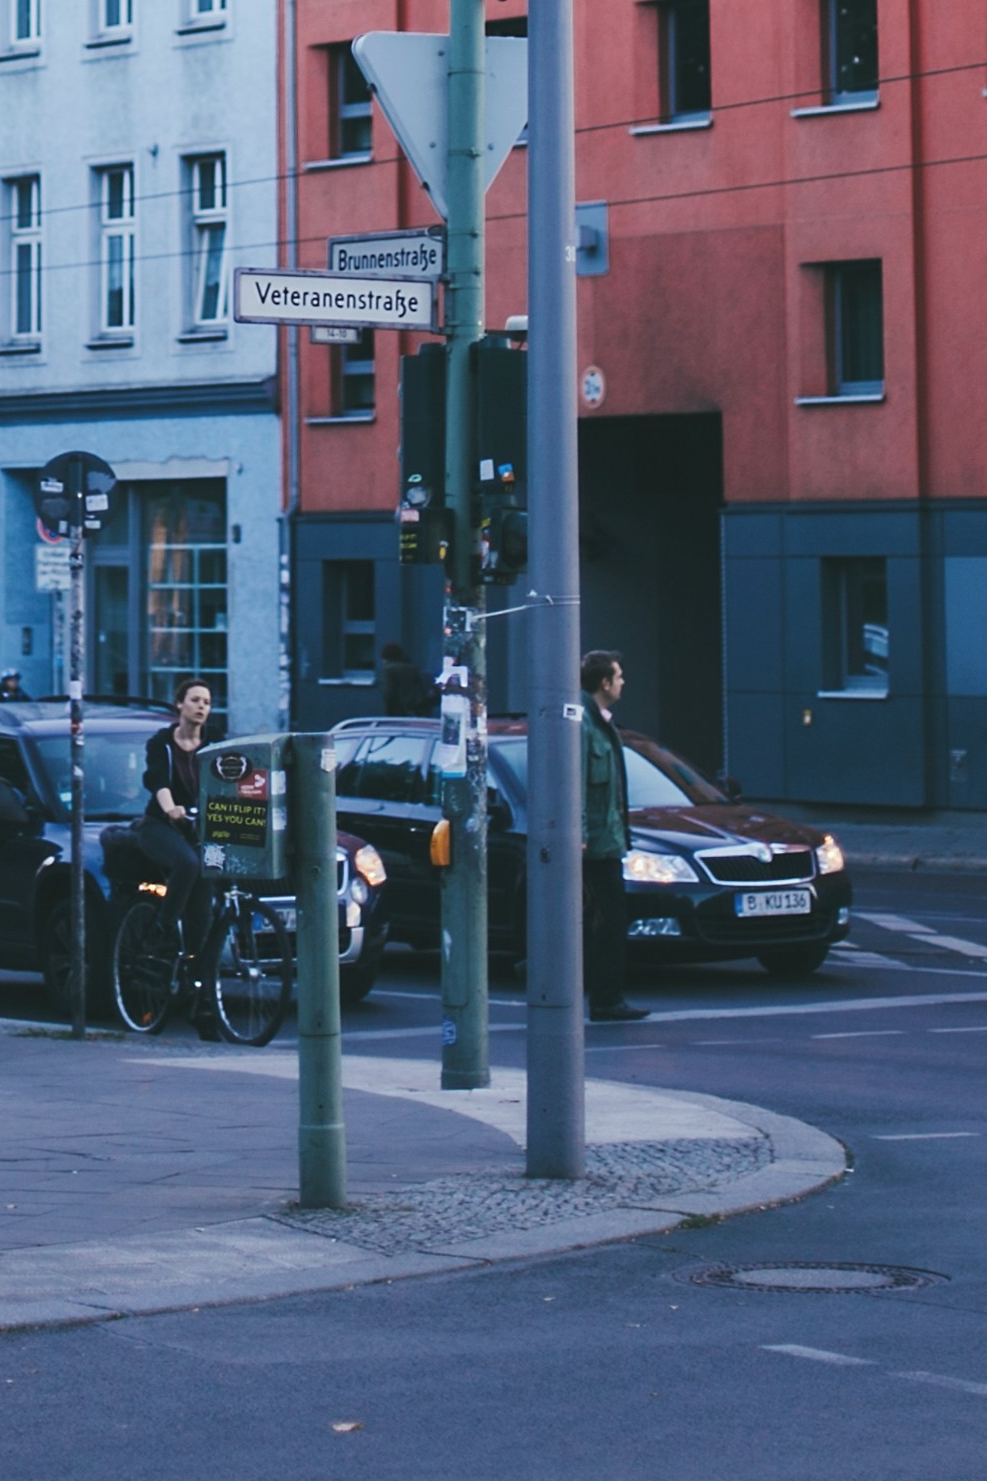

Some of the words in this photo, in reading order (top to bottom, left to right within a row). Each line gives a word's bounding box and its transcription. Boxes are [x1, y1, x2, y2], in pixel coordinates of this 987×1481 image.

[338, 243, 437, 272] Brunnenstraße
[255, 281, 419, 318] Veteranenstraße
[208, 802, 226, 812] CAN
[234, 803, 252, 814] FLIP
[253, 807, 266, 815] IT?
[207, 813, 222, 823] YES
[224, 815, 242, 825] YOU
[747, 895, 756, 911] B
[765, 894, 782, 910] KU
[784, 893, 807, 909] 136
